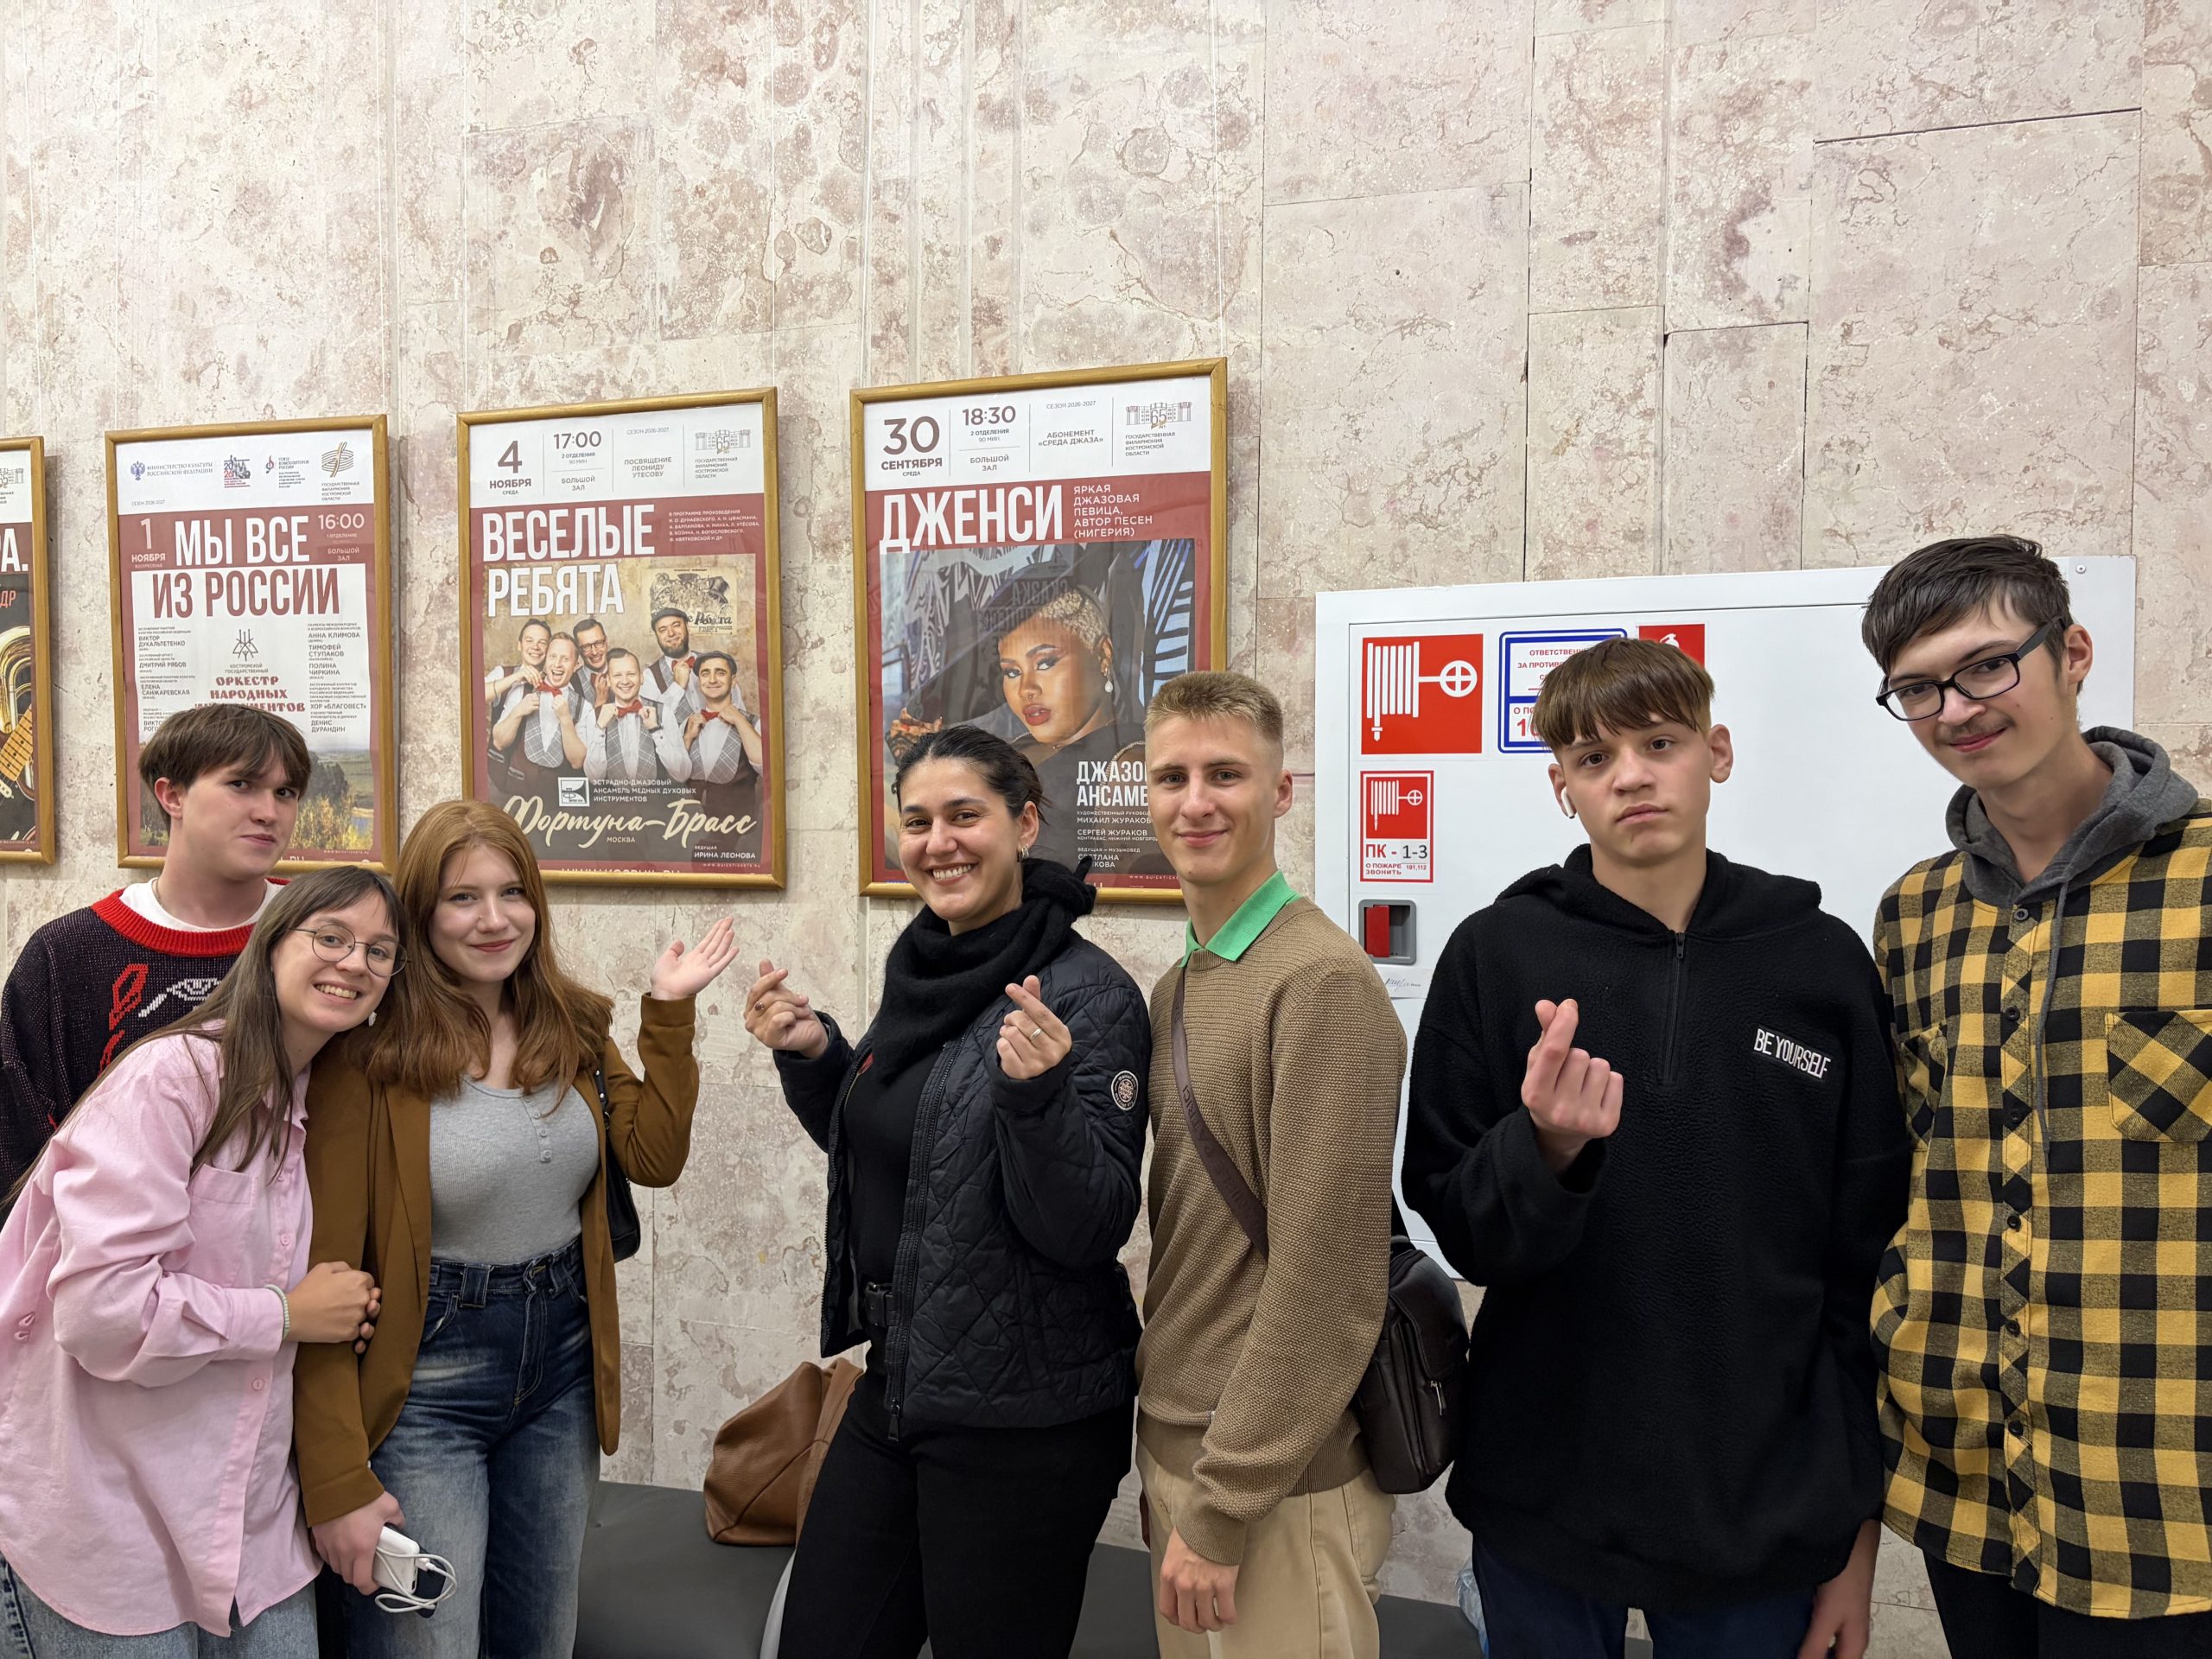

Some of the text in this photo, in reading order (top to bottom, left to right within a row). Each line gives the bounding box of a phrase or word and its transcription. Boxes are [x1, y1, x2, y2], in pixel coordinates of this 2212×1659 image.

[962, 405, 1016, 426] 18:30
[1150, 409, 1167, 426] 65
[553, 431, 602, 449] 17:00
[883, 416, 940, 455] 30
[1047, 430, 1095, 439] АБОНЕМЕНТ
[716, 435, 730, 451] 65
[1038, 437, 1103, 447] «СРЕДА ДЖАЗА»
[497, 440, 522, 474] 4
[624, 457, 672, 465] ПОСВЯЩЕНИЕ
[881, 458, 943, 470] СЕНТЯБРЯ
[970, 454, 1009, 464] БОЛЬШОЙ
[489, 478, 532, 489] НОЯБРЯ
[562, 475, 595, 484] БОЛЬШОЙ
[1074, 484, 1111, 495] ЯРКАЯ
[1074, 494, 1140, 507] ДЖАЗОВАЯ
[1074, 506, 1123, 516] ПЕВИЦА,
[318, 512, 365, 530] 16:00
[879, 485, 1063, 555] ДЖЕНСИ
[1074, 516, 1153, 527] АВТОР ПЕСЕН
[140, 518, 153, 550] 1
[482, 504, 655, 562] ВЕСЕЛЫЕ
[1074, 527, 1135, 539] (НИГЕРИЯ)
[175, 515, 310, 567] МЫ ВСЕ
[327, 546, 359, 555] БОЛЬШОЙ
[131, 553, 166, 563] НОЯБРЯ
[152, 568, 340, 619] ИЗ РОССИИ
[488, 564, 624, 617] РЕБЯТА
[216, 676, 279, 686] ОРКЕСТР
[210, 690, 288, 701] НАРОДНЫХ
[1076, 761, 1148, 785] ДЖАЗО
[1365, 844, 1428, 859] ПК 1-3
[1754, 1028, 1831, 1079] BE YOURSELF
